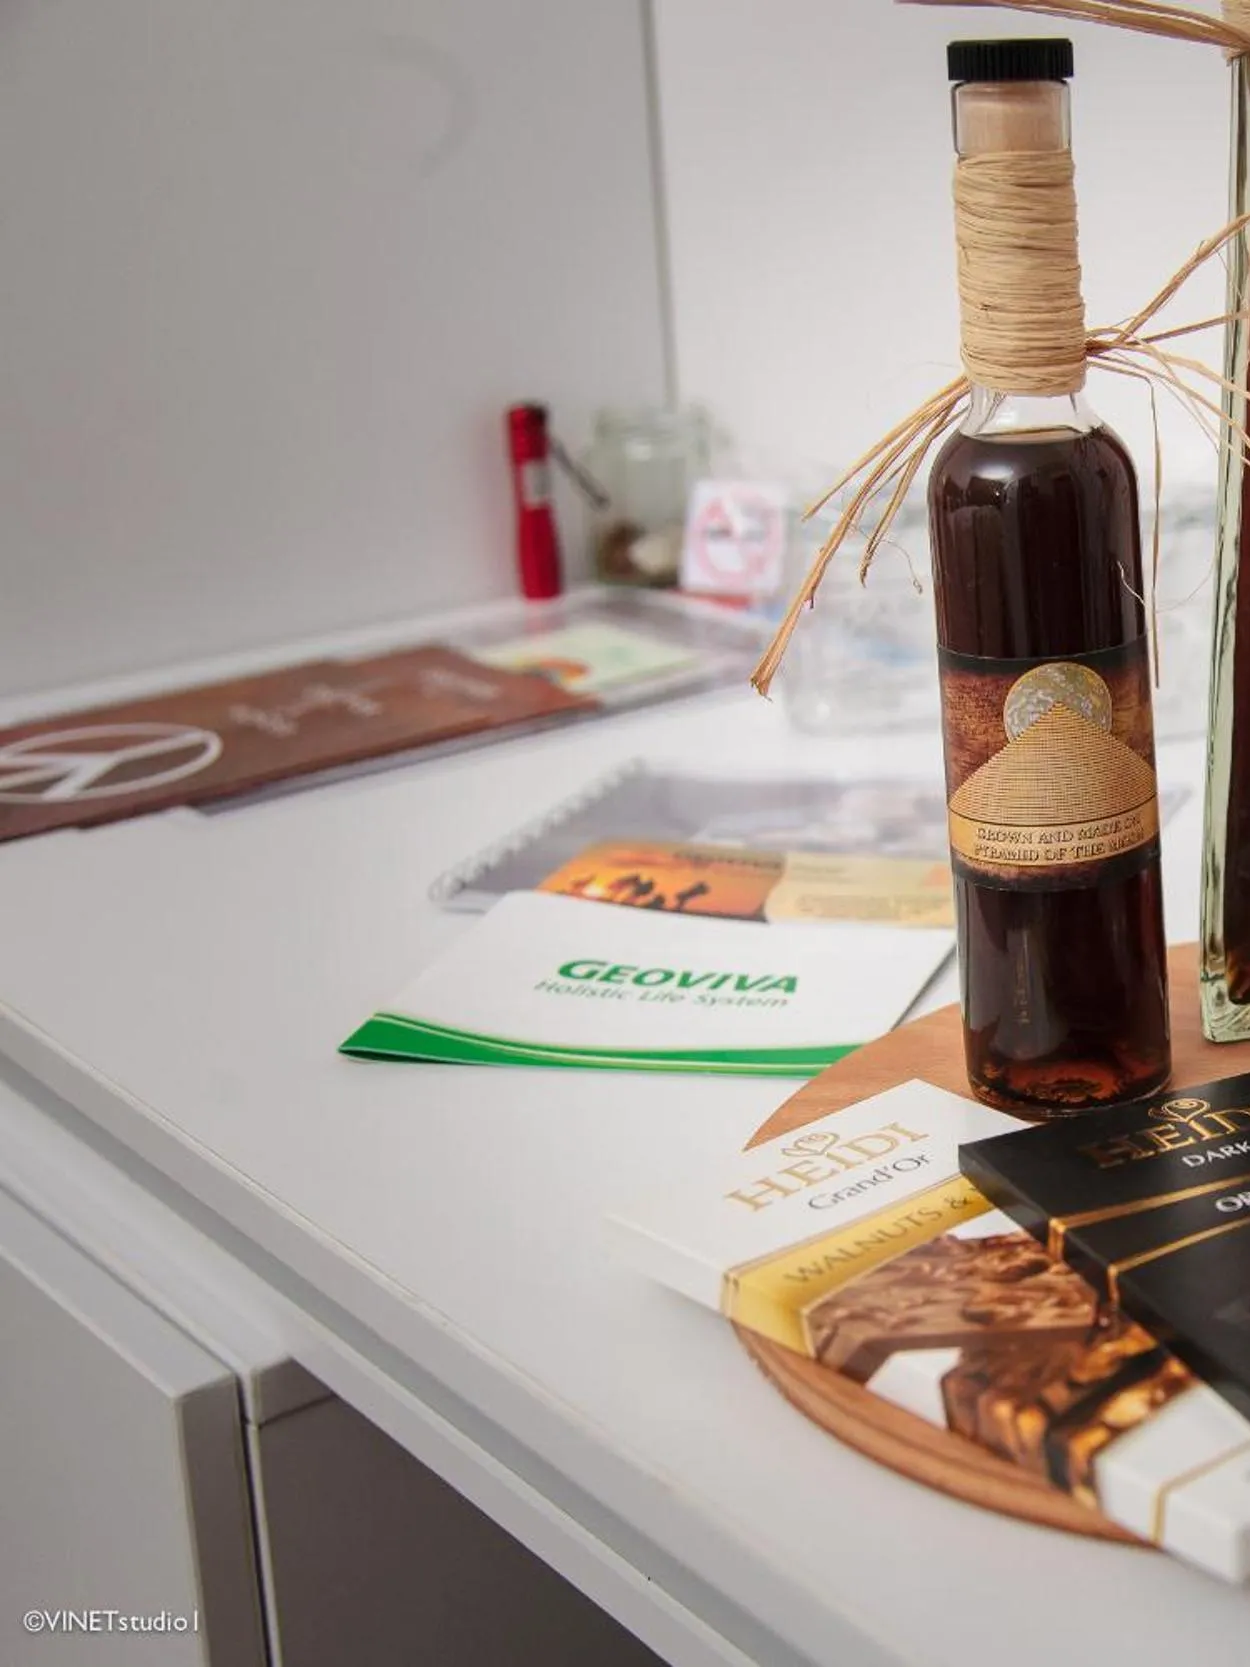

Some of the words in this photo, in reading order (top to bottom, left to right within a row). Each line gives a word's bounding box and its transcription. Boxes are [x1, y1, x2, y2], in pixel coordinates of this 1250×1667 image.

[1038, 830, 1073, 844] AND
[1044, 849, 1068, 860] OF
[1071, 843, 1105, 859] THE
[533, 978, 629, 1001] Holistic
[639, 989, 686, 1004] Life
[692, 993, 789, 1008] System
[557, 959, 799, 995] GEOVIVA
[723, 1121, 929, 1212] HEIDI
[808, 1151, 933, 1210] Grand'Or
[783, 1206, 943, 1283] WALNUTS
